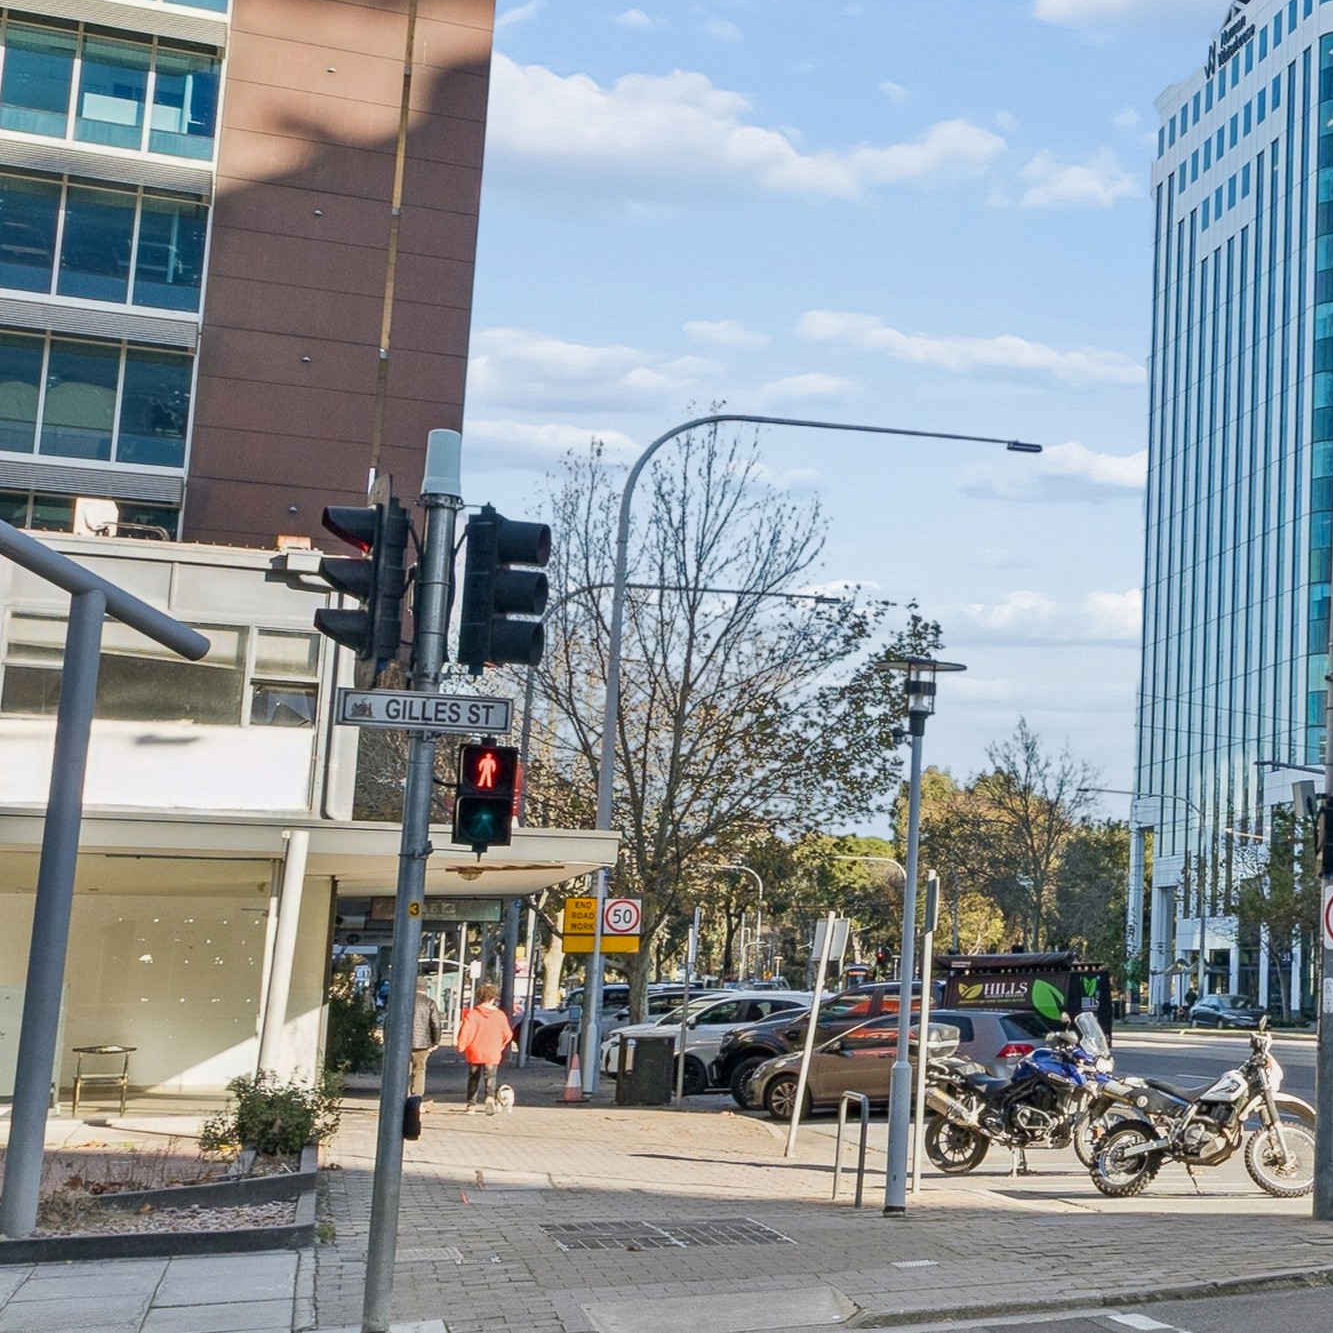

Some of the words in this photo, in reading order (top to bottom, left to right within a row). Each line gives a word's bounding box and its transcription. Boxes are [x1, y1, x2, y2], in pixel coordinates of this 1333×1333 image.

[385, 698, 461, 724] GILLES
[467, 703, 494, 725] ST
[409, 903, 419, 916] 3
[575, 901, 592, 909] END
[613, 909, 632, 924] 50
[984, 982, 1028, 995] HILLS
